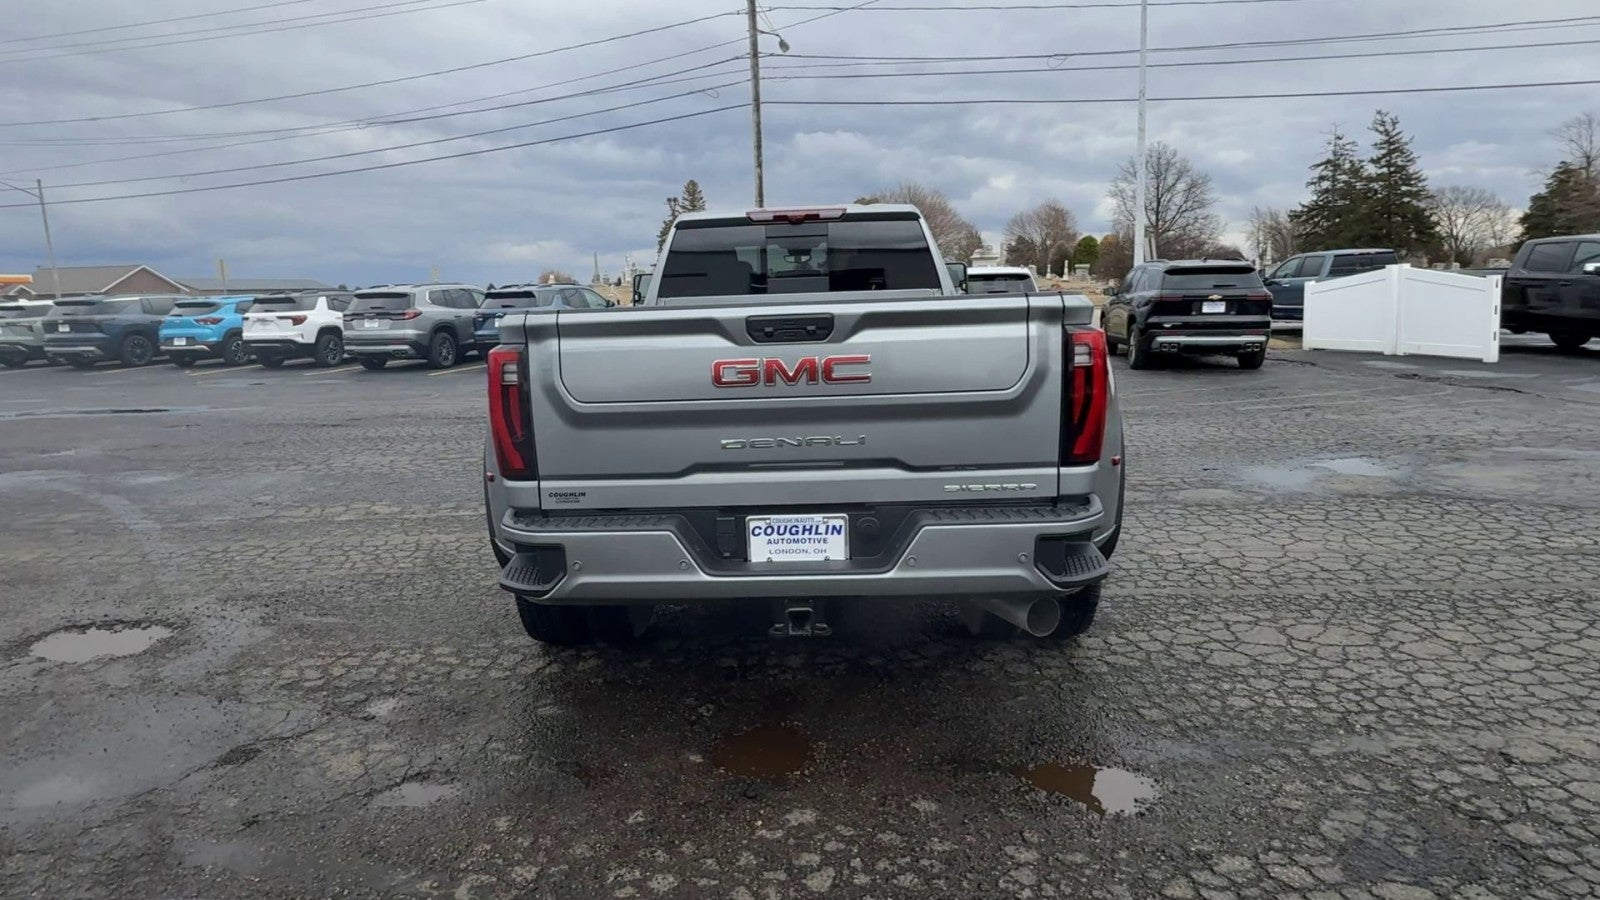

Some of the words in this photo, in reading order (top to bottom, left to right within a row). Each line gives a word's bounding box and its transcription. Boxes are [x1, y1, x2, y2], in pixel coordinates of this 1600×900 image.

[711, 354, 872, 388] GMC
[720, 434, 866, 450] DENALI
[943, 483, 1037, 492] SIERRA
[751, 524, 843, 537] COUGHLIN
